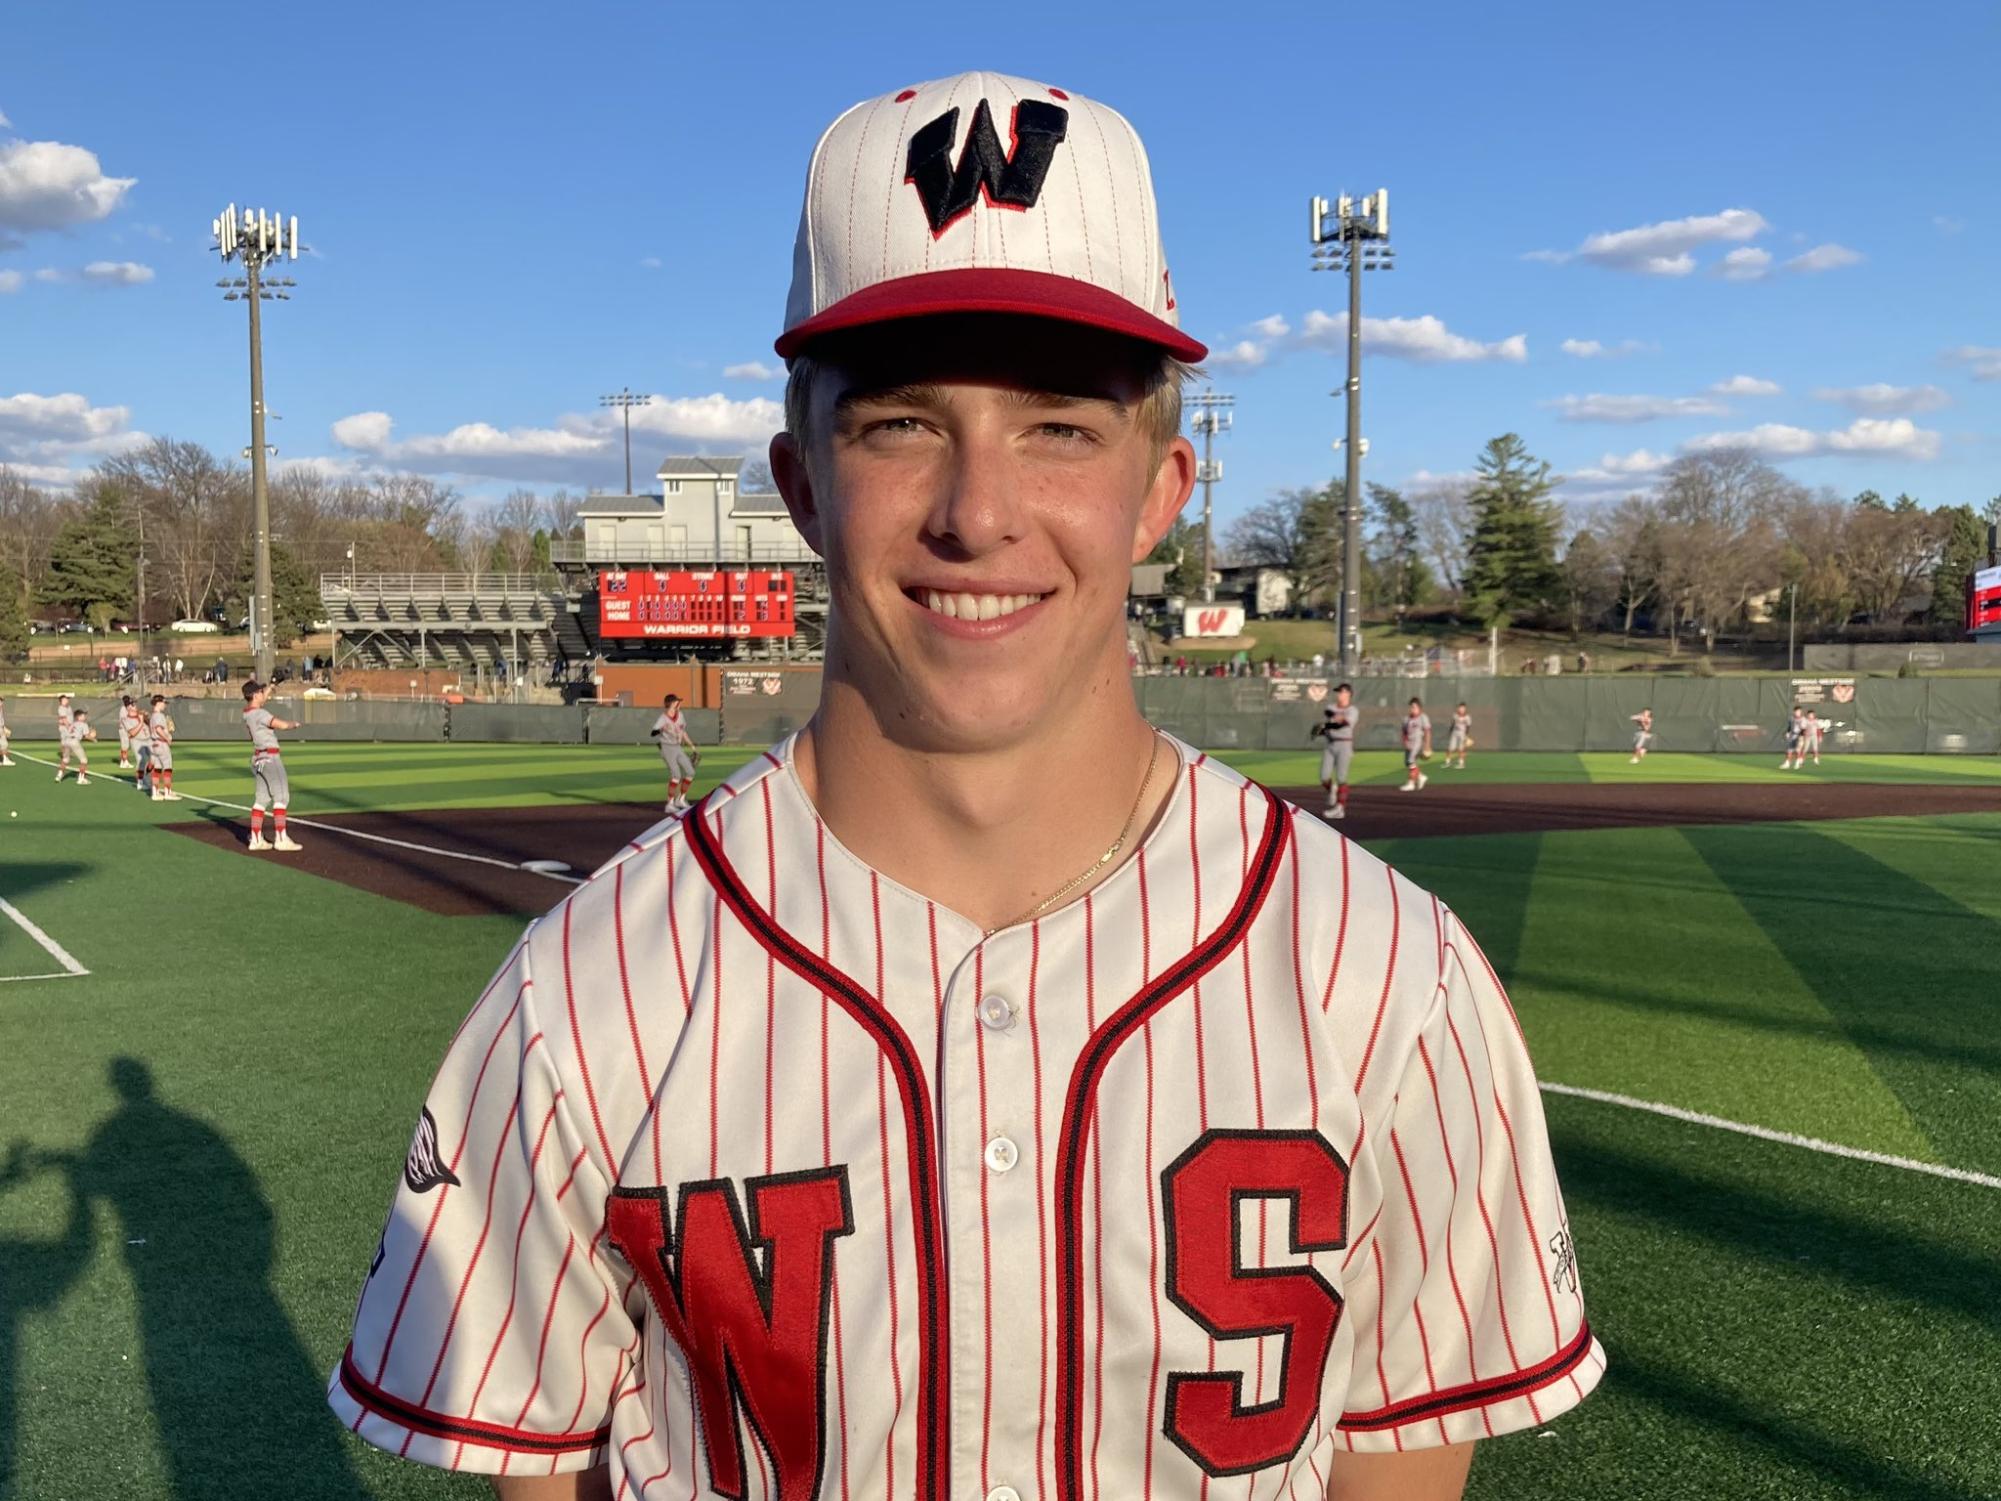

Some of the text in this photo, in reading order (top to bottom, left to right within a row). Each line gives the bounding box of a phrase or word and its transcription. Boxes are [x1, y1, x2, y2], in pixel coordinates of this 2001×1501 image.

[904, 98, 1069, 240] W
[654, 572, 670, 580] BALL
[606, 600, 631, 610] GUEST
[607, 611, 630, 620] HOME
[1199, 608, 1227, 633] W
[644, 624, 751, 634] WARRIOR FIELD
[606, 1129, 1350, 1501] W S
